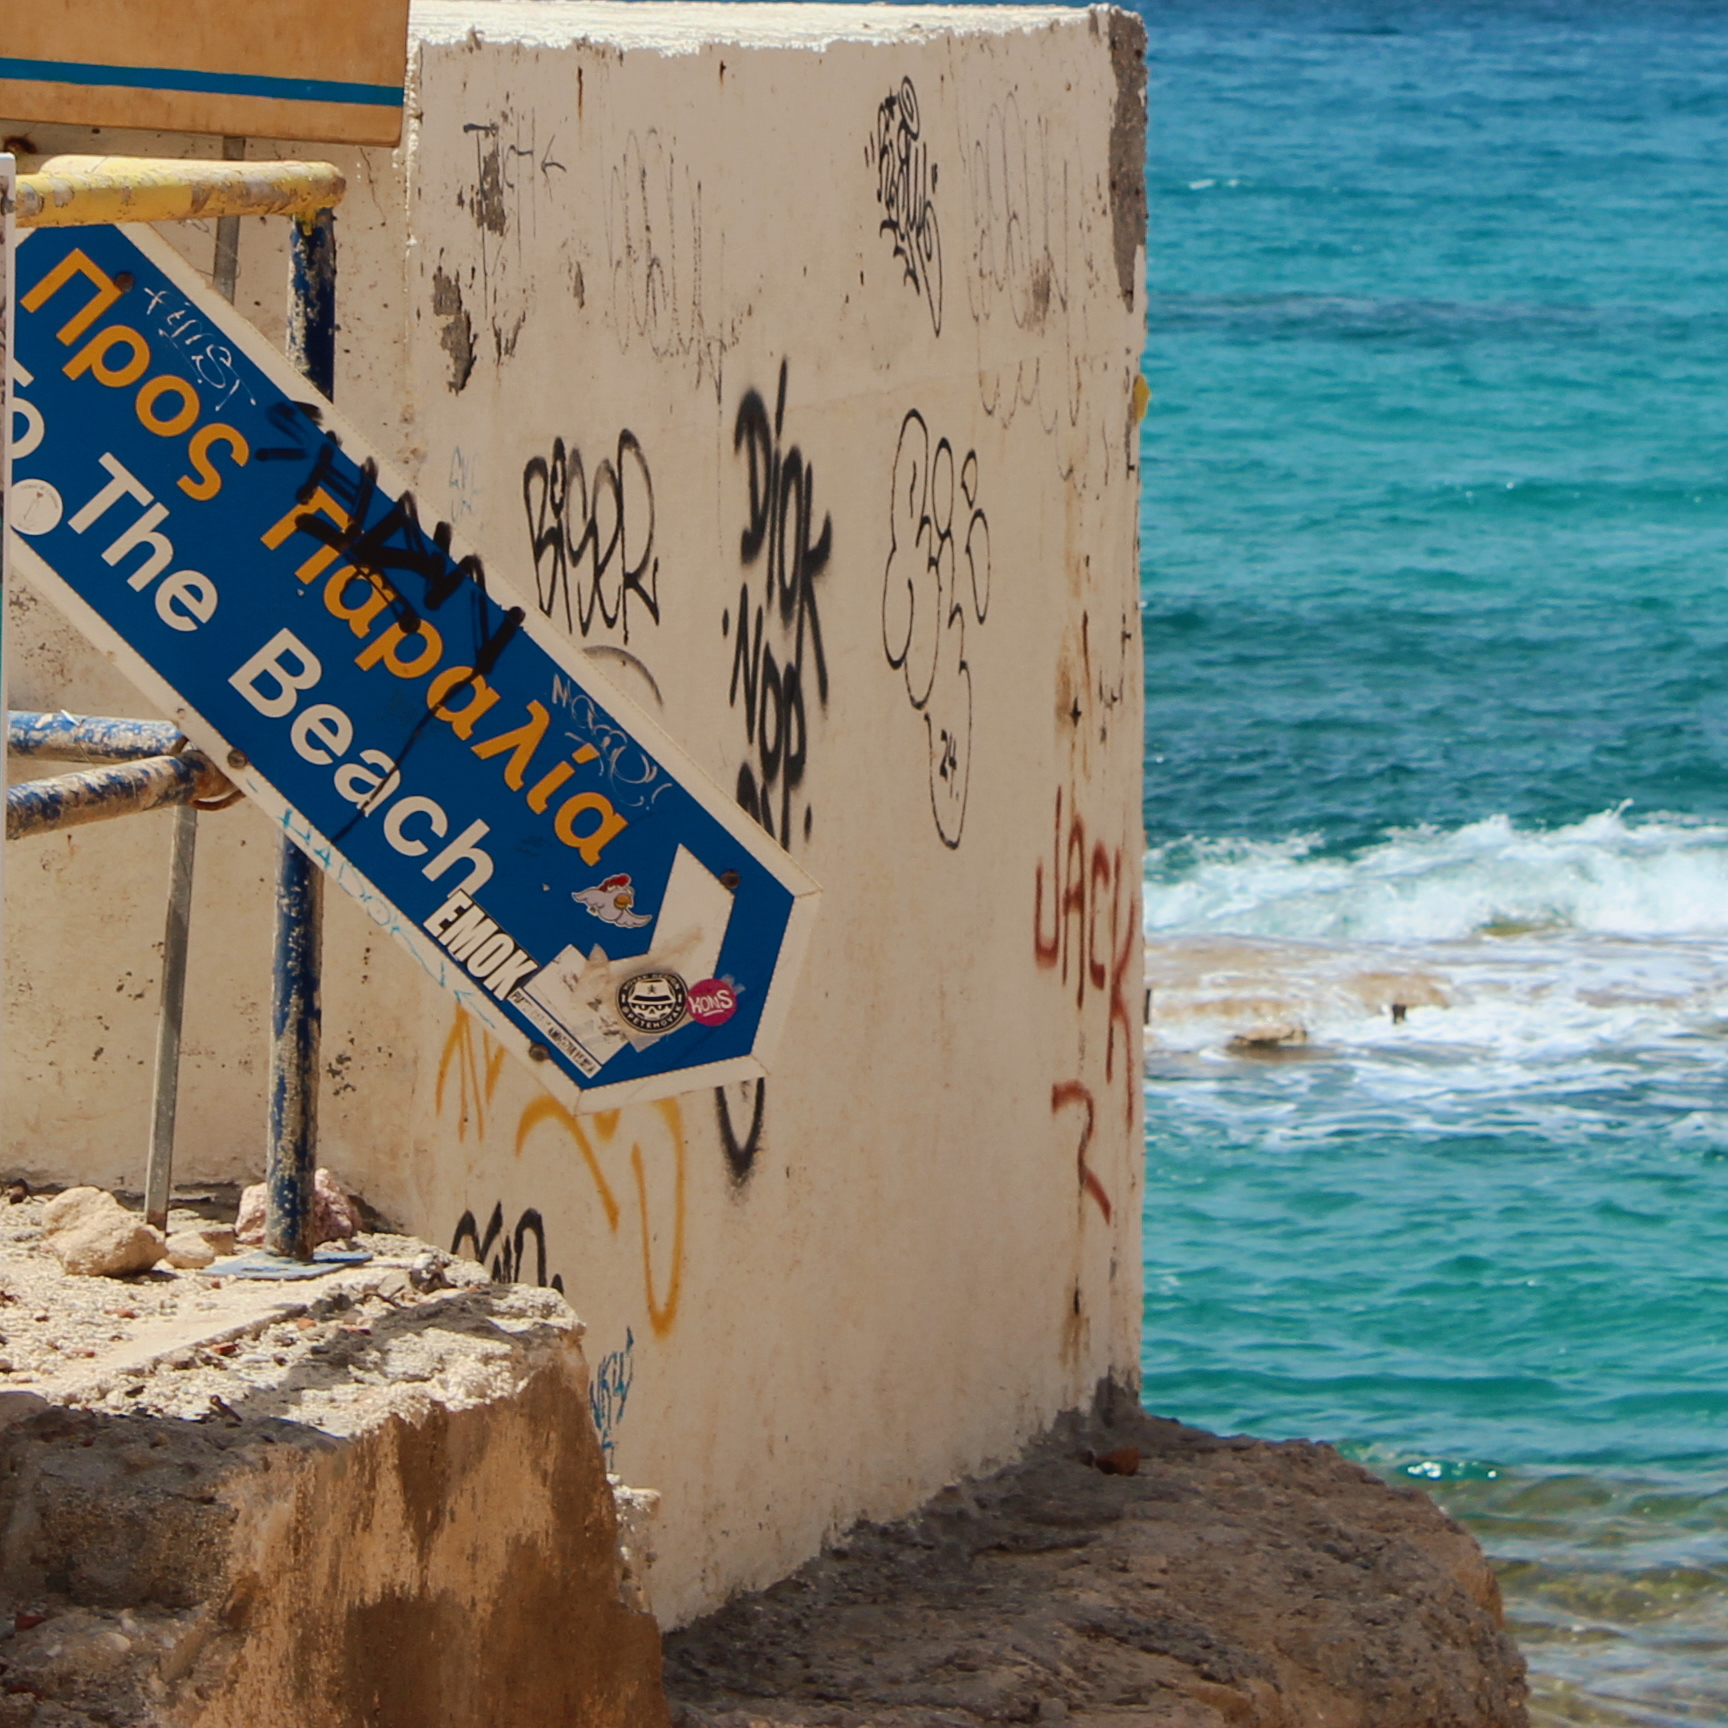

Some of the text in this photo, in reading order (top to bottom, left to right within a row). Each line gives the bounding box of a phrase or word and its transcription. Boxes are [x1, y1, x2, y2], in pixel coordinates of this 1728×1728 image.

[20, 247, 250, 501] Προς
[259, 484, 629, 866] Παραλία
[67, 451, 219, 632] The
[227, 627, 496, 896] Beach
[423, 887, 539, 1002] EMOK
[688, 989, 733, 1016] KONS
